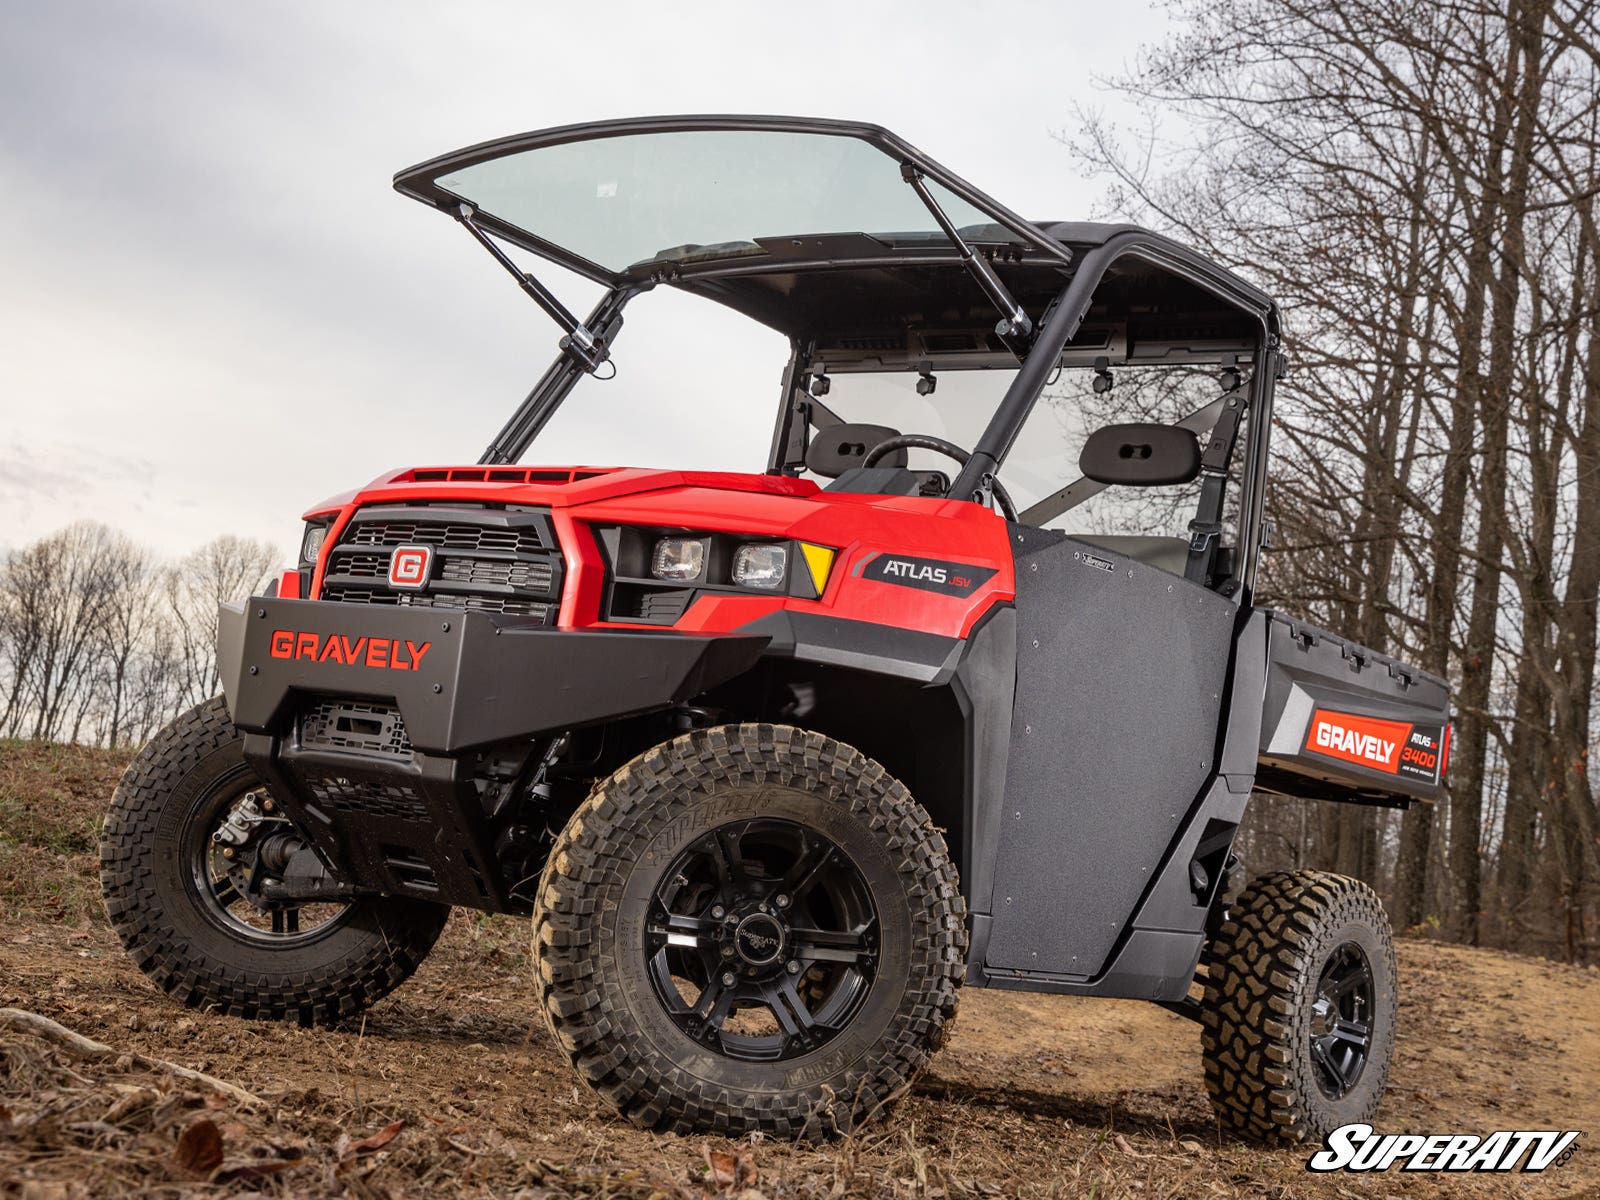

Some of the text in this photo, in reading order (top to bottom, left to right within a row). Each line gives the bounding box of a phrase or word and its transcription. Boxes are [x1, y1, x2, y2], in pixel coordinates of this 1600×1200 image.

[883, 560, 971, 588] ATLAS JSV
[270, 630, 432, 671] GRAVELY
[1316, 721, 1395, 764] GRAVELY
[1402, 746, 1436, 768] 3400
